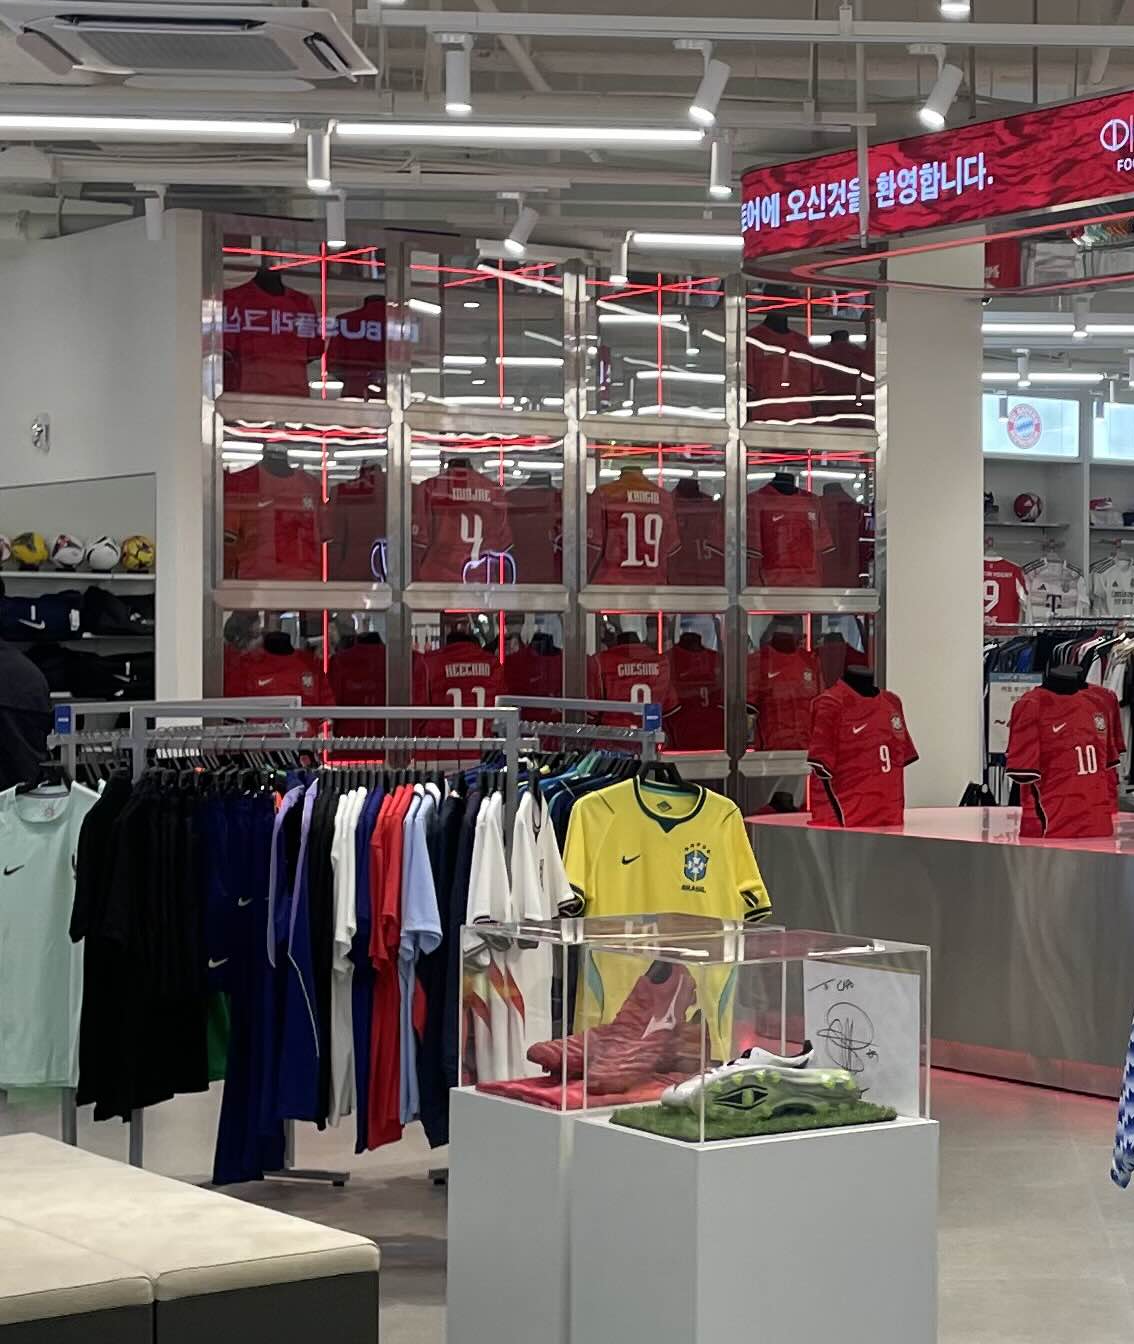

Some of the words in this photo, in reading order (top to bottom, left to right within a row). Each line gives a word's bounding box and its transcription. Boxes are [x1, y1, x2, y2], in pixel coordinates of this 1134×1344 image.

[875, 152, 994, 208] 환영합니다.
[461, 512, 483, 567] 4
[620, 512, 663, 568] 19
[446, 687, 486, 738] 11
[879, 744, 891, 773] 9
[1075, 744, 1098, 775] 10
